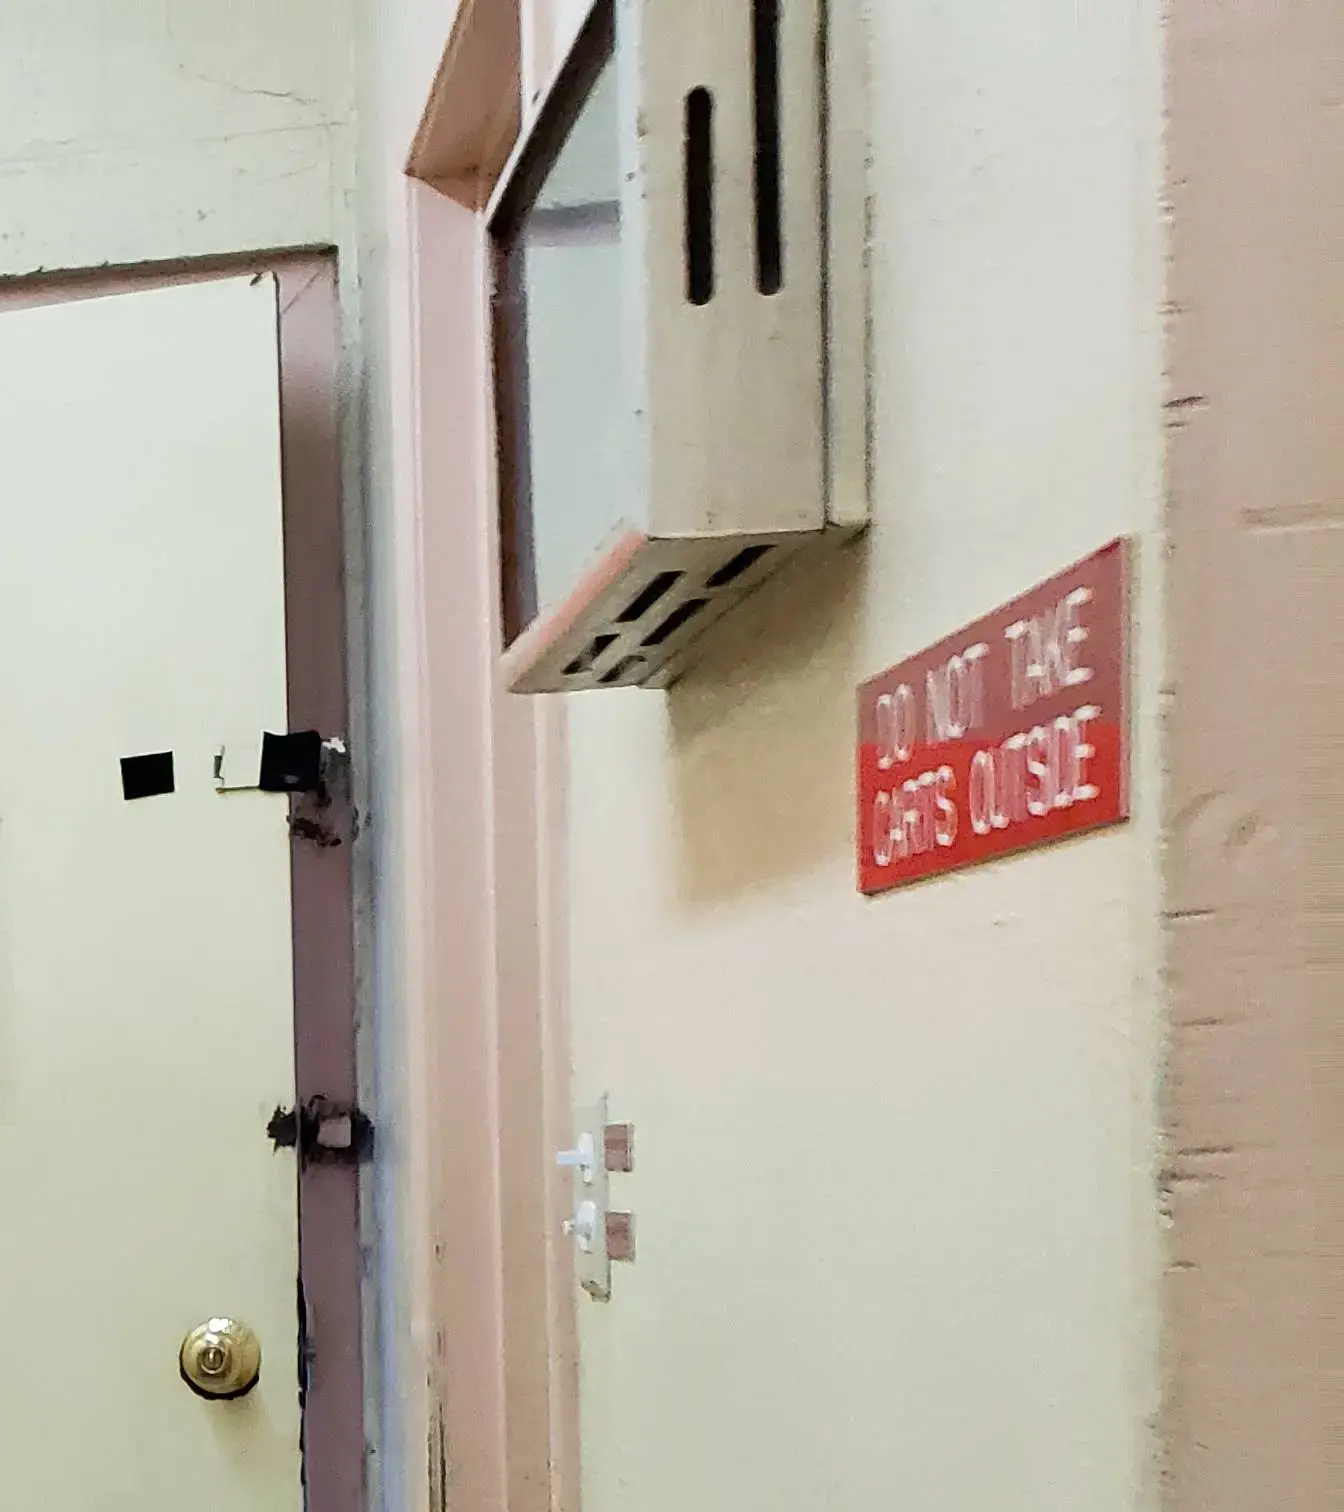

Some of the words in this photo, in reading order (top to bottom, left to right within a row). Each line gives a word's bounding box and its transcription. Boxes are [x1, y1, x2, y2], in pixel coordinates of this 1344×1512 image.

[876, 684, 916, 769] DO
[926, 642, 990, 744] NOT
[1004, 587, 1094, 709] TAKE
[873, 765, 958, 866] CARTS
[969, 705, 1102, 835] OUTSIDE
